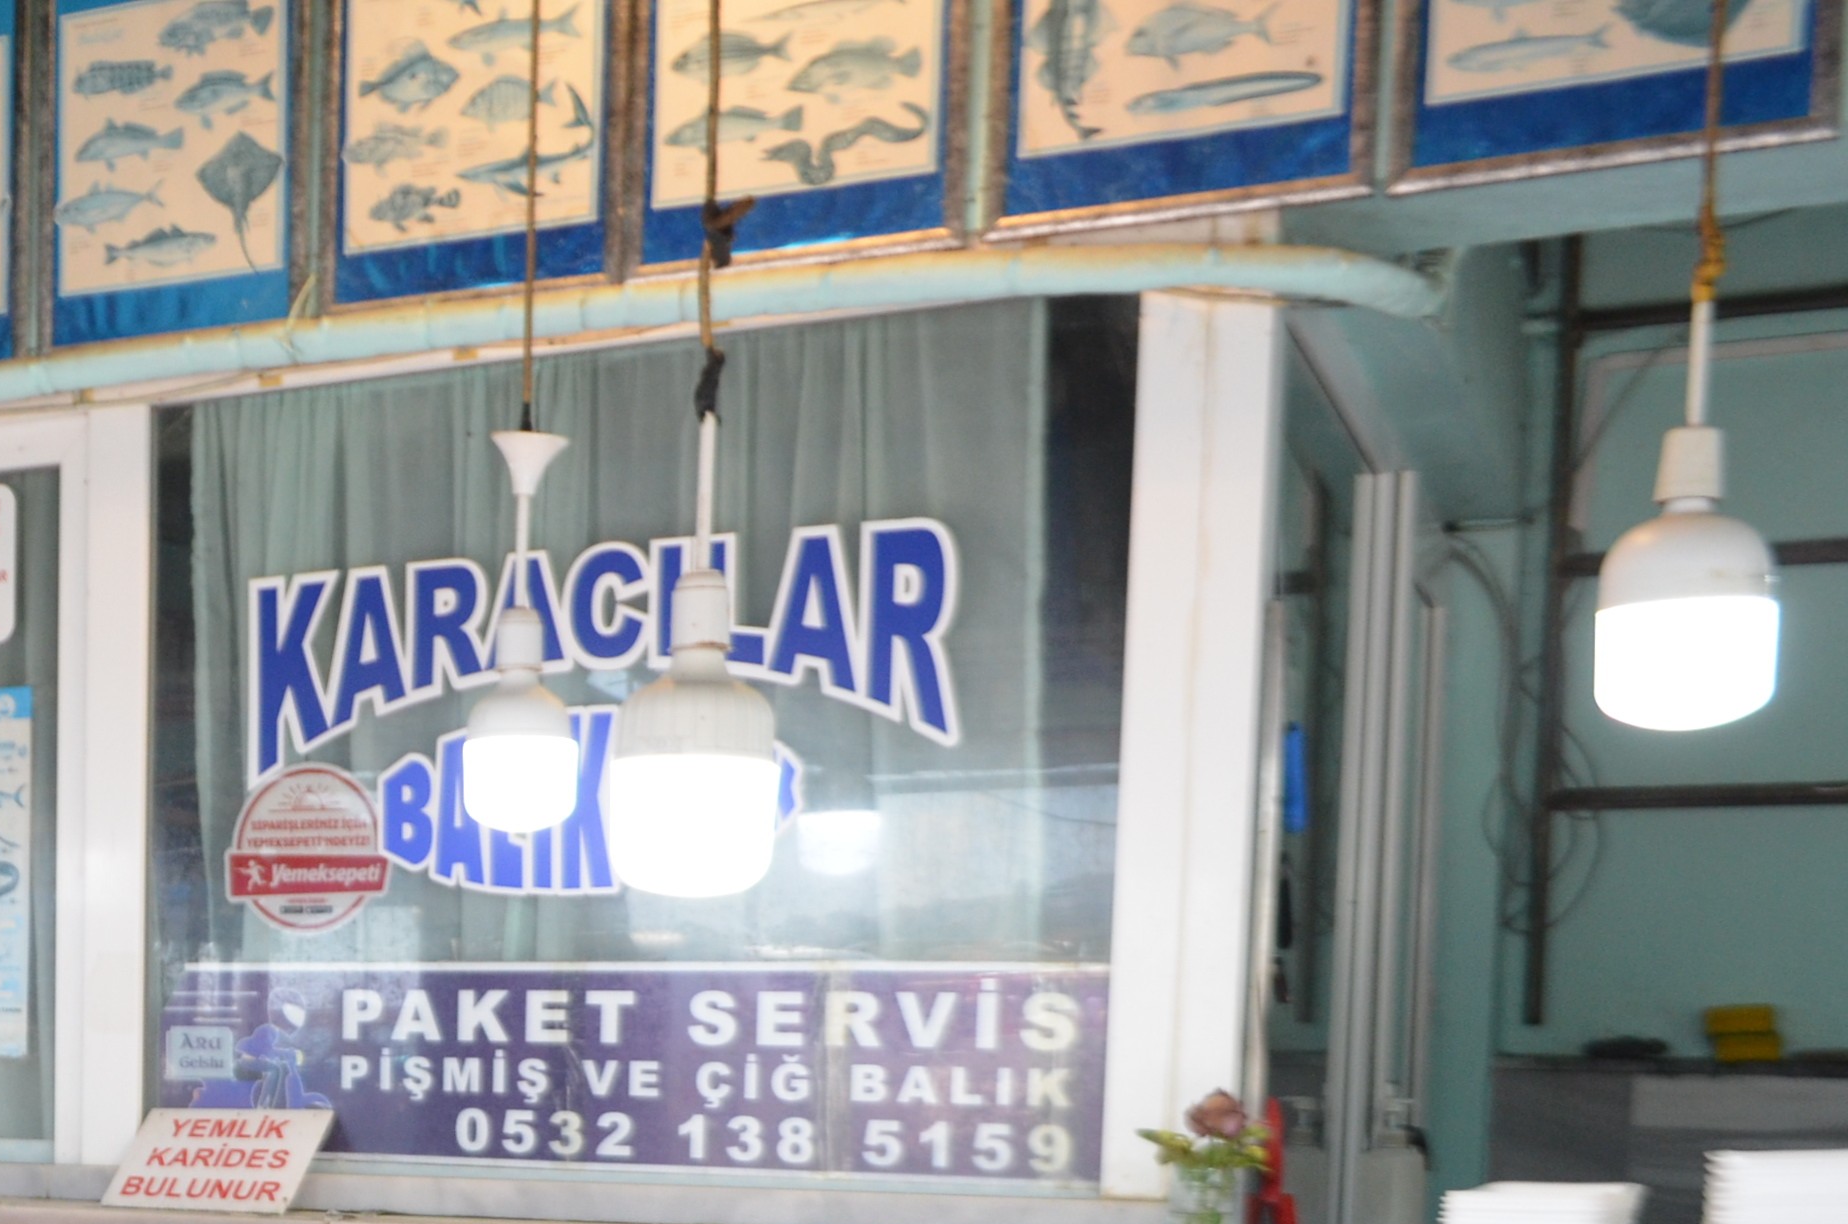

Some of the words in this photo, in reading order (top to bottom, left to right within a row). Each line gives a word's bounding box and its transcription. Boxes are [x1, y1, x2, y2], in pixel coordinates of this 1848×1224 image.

[269, 862, 381, 888] Yemeksepeti
[341, 988, 636, 1044] PAKET
[687, 977, 1080, 1052] SERVİS
[340, 1048, 549, 1103] PİŞMİŞ
[584, 1060, 661, 1098] VE
[695, 1054, 813, 1108] ÇİĞ
[849, 1063, 1072, 1108] BALIK
[172, 1116, 290, 1139] YEMLİK
[455, 1107, 633, 1156] 0532
[678, 1114, 815, 1163] 138
[862, 1119, 1073, 1173] 5159
[146, 1143, 290, 1168] KARİDES
